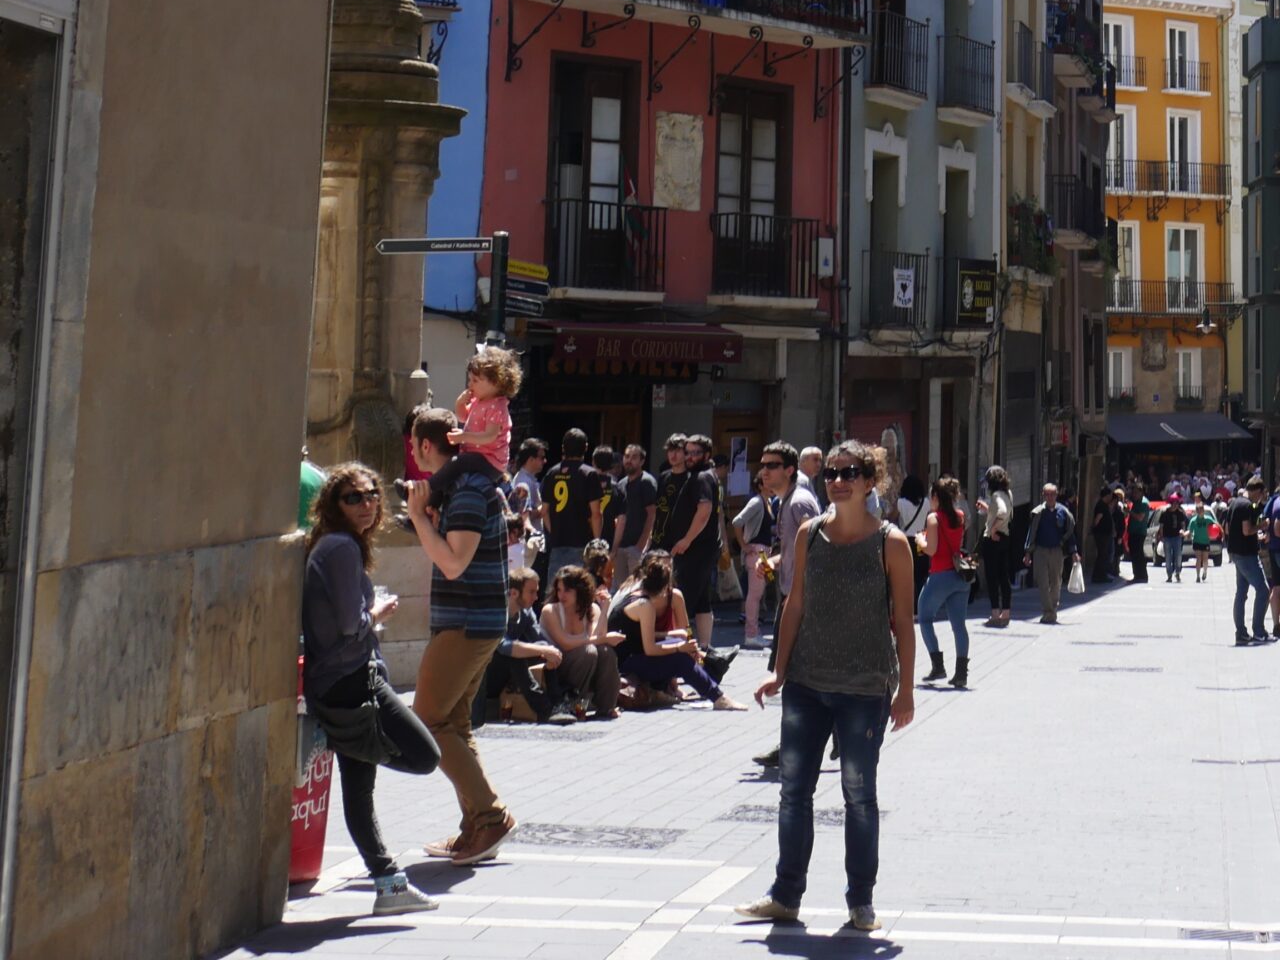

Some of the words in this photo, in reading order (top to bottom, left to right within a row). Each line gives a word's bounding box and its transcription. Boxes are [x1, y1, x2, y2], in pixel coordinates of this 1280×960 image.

[596, 337, 621, 358] BAR
[631, 338, 704, 359] CORDOVILLA
[554, 480, 569, 513] 9
